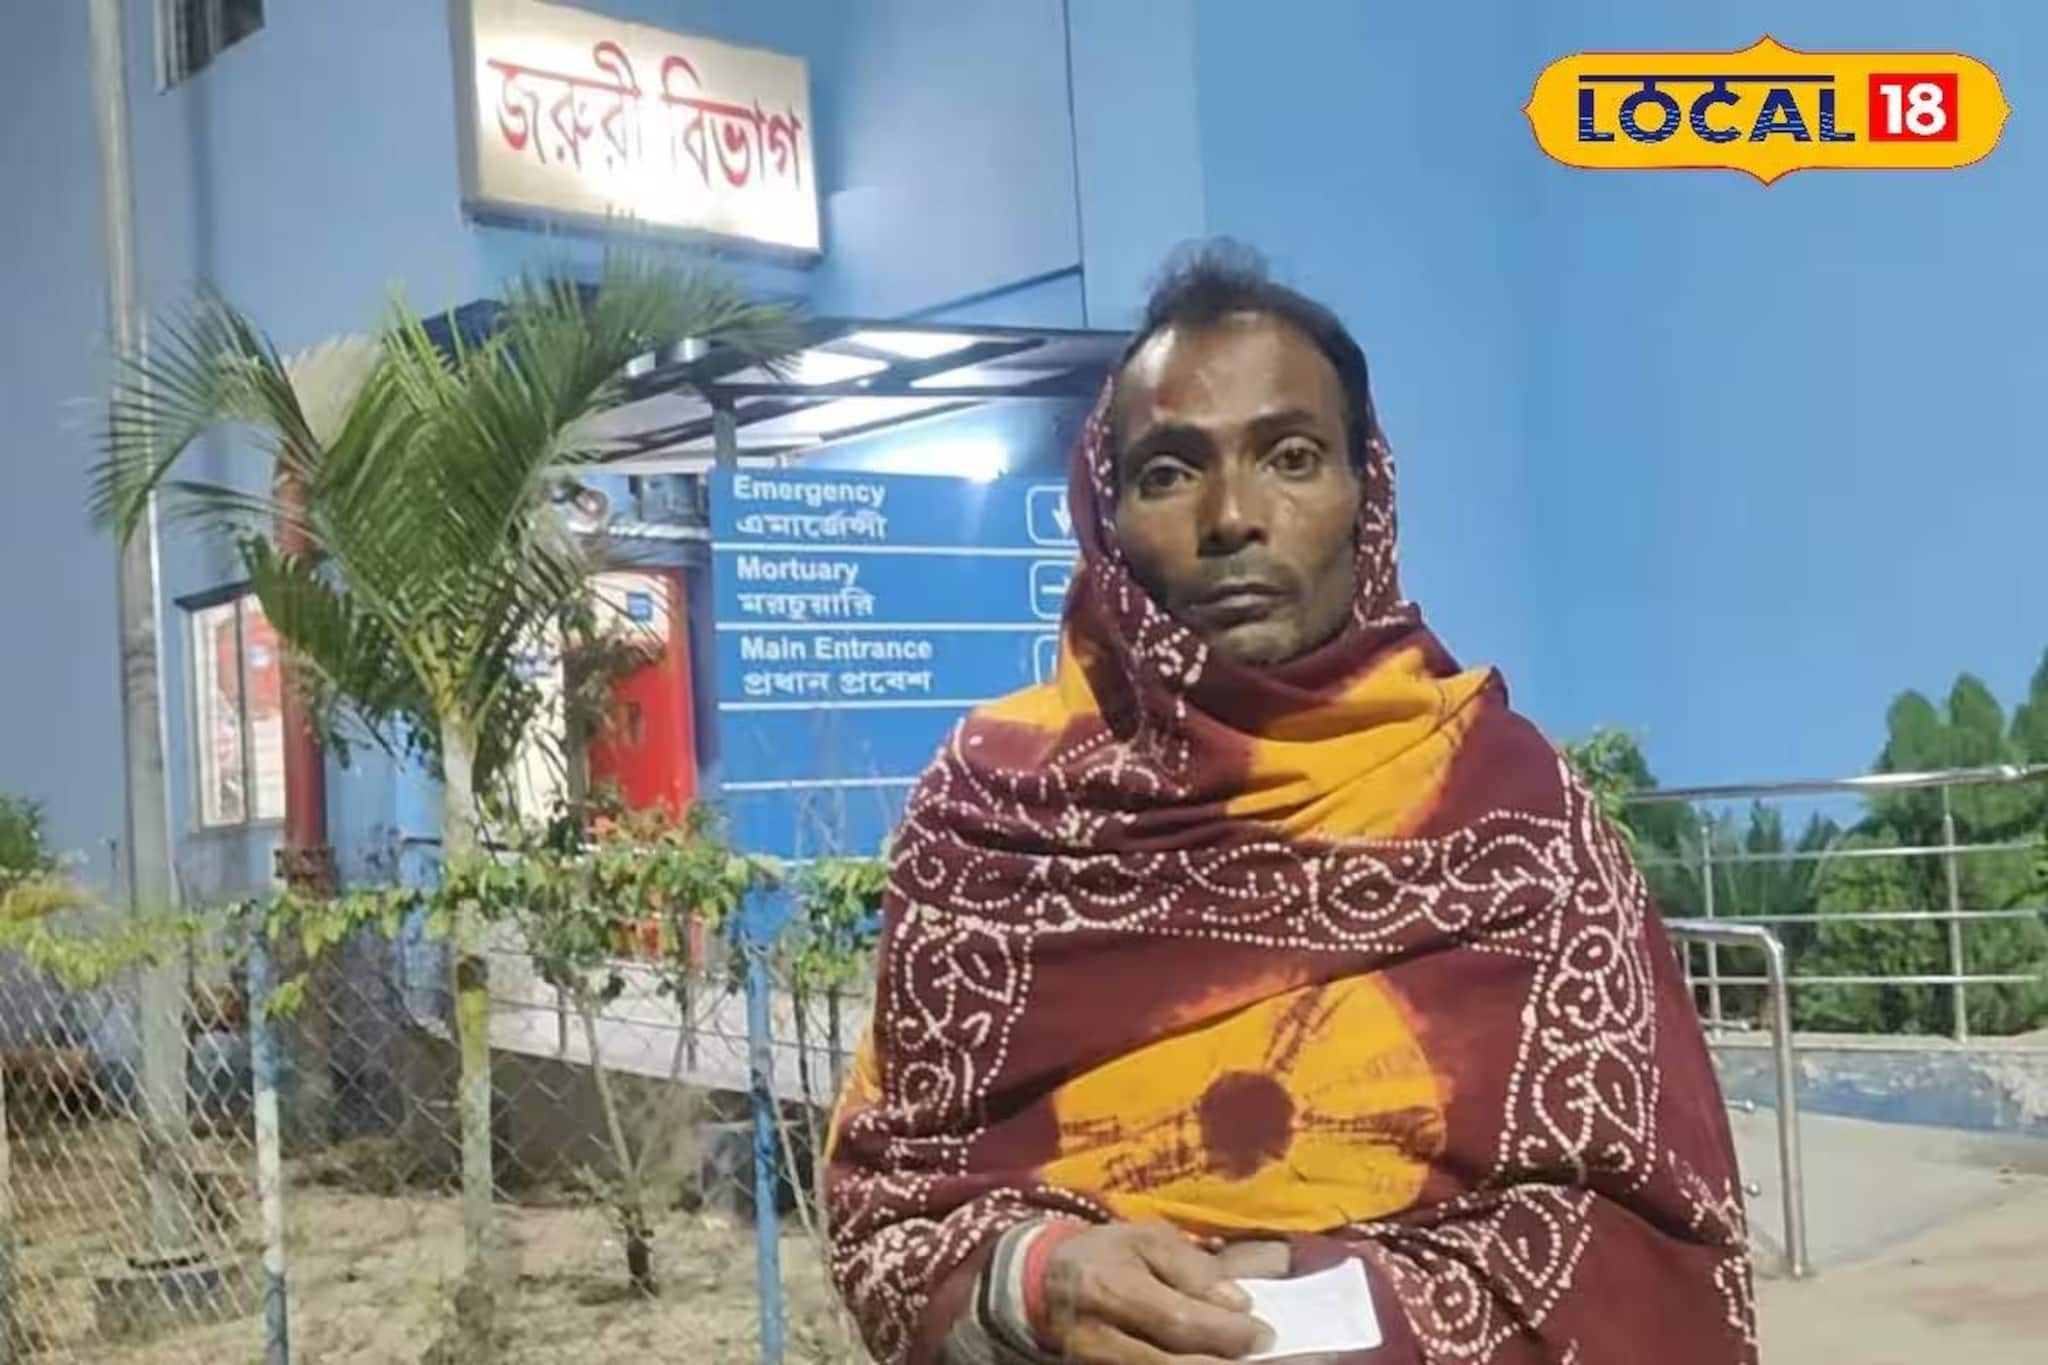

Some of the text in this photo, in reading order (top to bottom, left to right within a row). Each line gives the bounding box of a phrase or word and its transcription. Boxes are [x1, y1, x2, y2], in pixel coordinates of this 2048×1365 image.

[486, 41, 803, 190] জরুরী বিভাগ
[733, 475, 886, 506] Emergency
[737, 556, 859, 585] Mortuary
[740, 636, 934, 661] Main Entrance
[743, 669, 934, 697] প্রধান প্রবেশ
